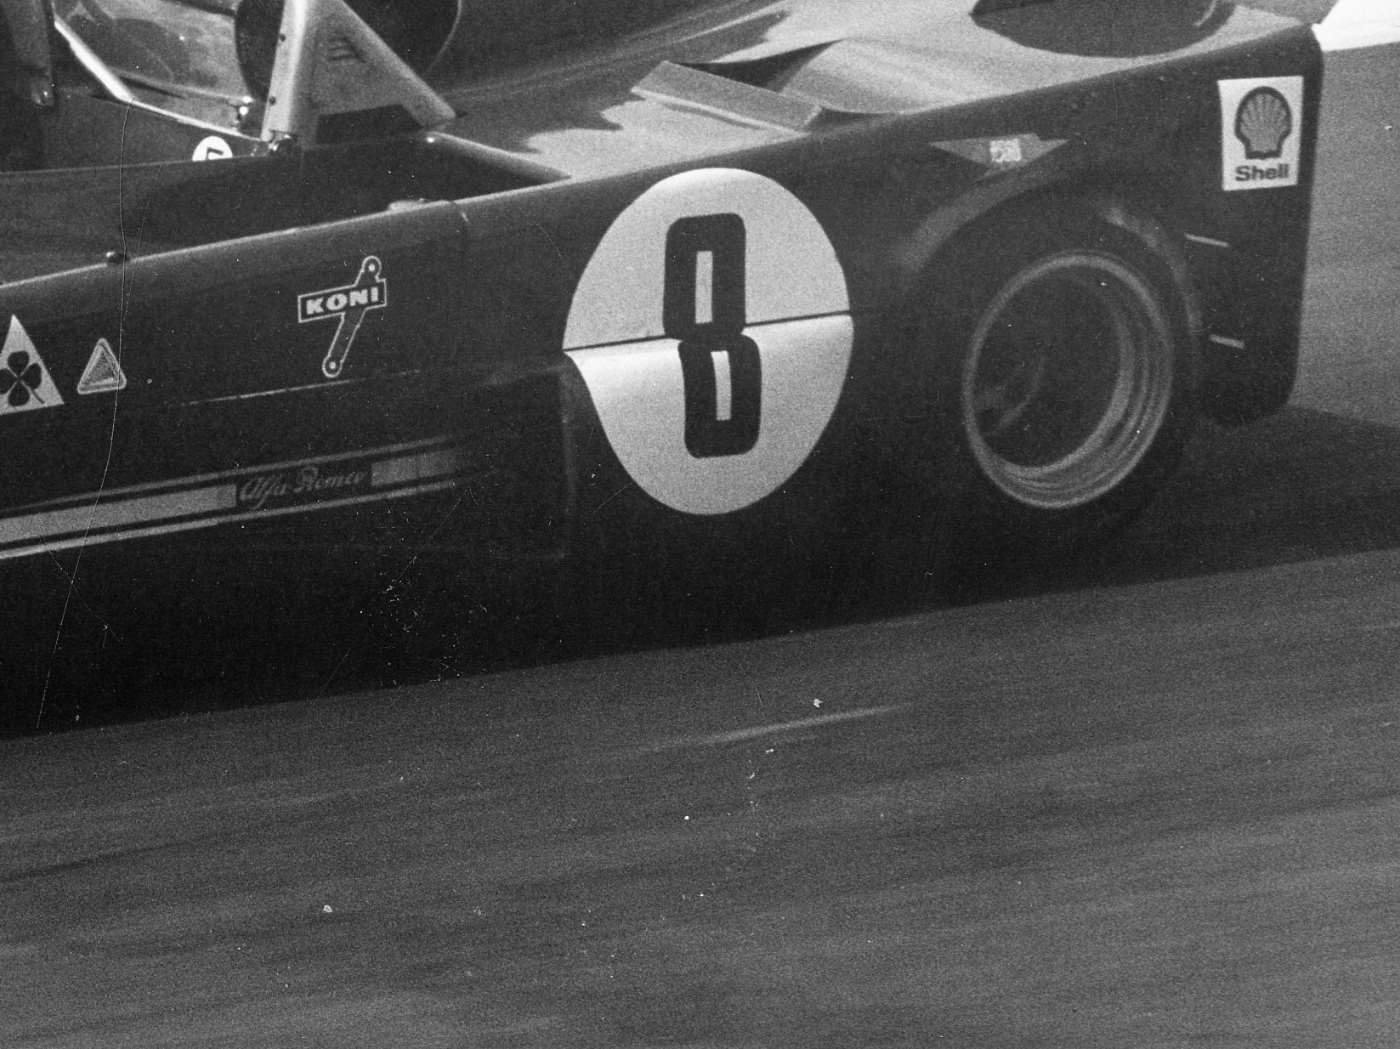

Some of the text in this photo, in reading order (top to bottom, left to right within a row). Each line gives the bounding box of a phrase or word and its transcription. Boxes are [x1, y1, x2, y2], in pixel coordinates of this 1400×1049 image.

[1235, 163, 1289, 182] Shell
[306, 286, 378, 314] KONI
[662, 212, 761, 458] 8
